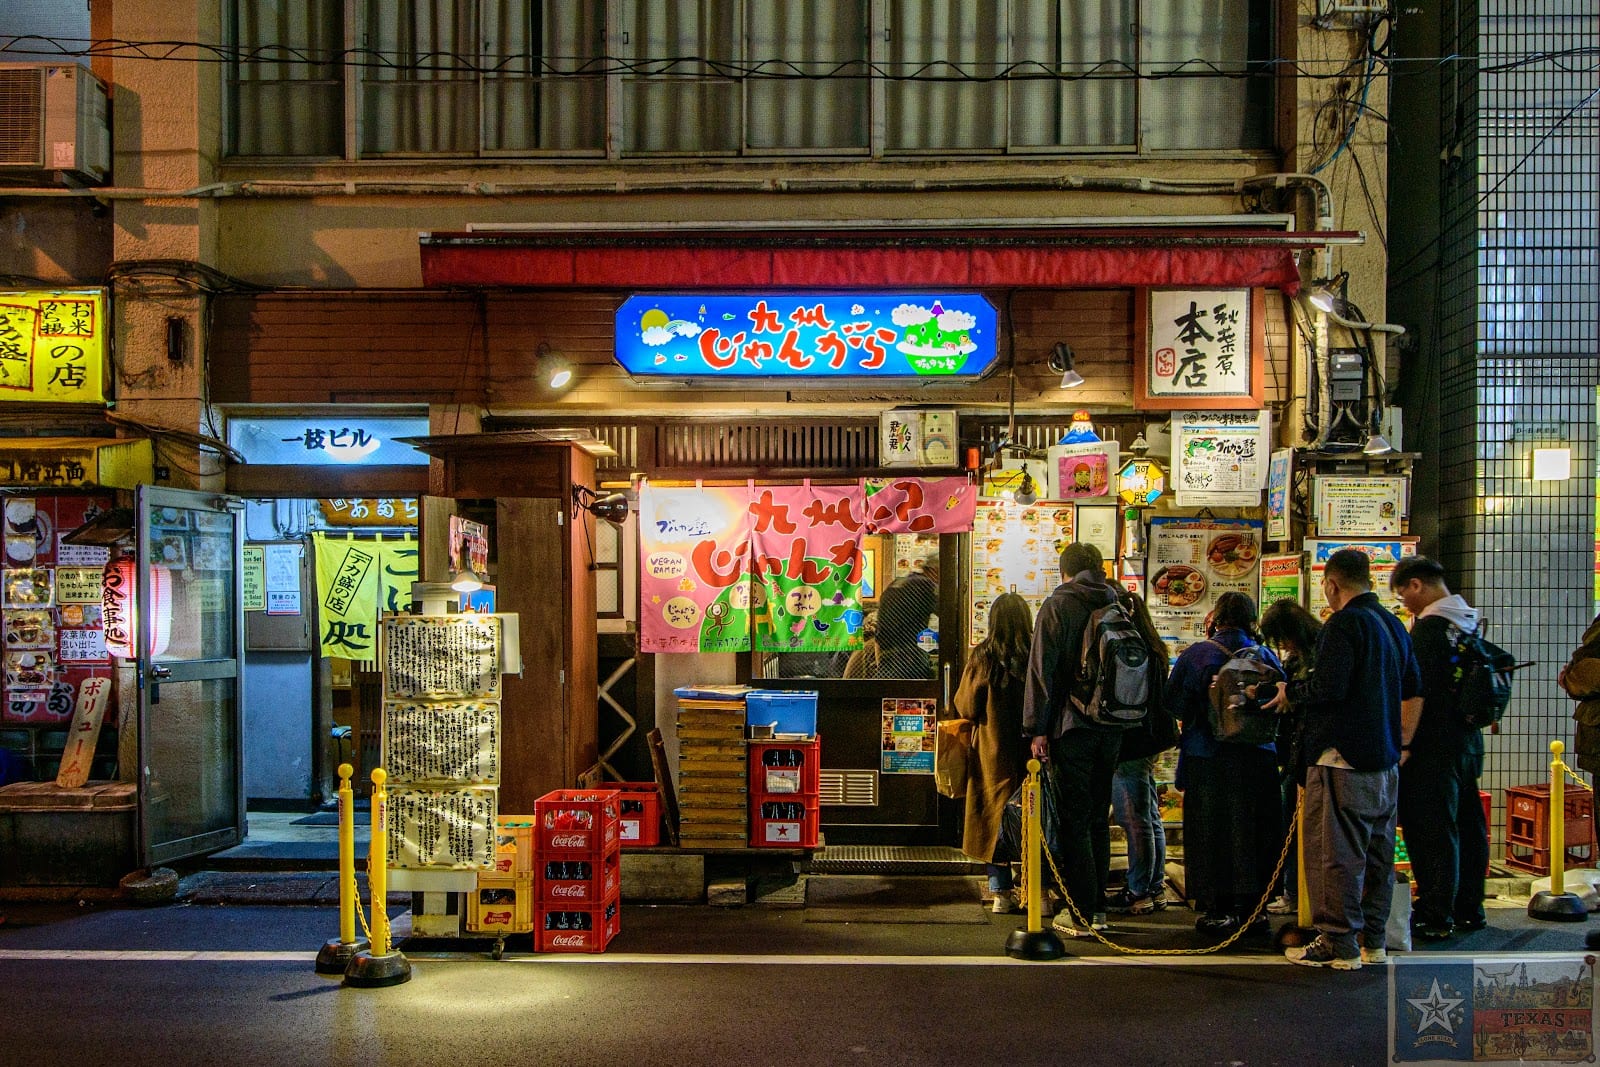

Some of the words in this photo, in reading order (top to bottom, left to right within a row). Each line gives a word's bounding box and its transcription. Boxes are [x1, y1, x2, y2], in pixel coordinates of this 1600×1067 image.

[69, 302, 93, 335] お米
[748, 301, 835, 334] 九州
[699, 321, 897, 370] じゃんがら
[1171, 301, 1215, 388] 本店
[1212, 303, 1239, 376] 秋葉原
[47, 345, 87, 388] の店
[281, 427, 373, 450] 一枝ビル
[650, 557, 682, 566] VEGAN
[653, 566, 682, 575] RAMEN
[329, 553, 374, 612] デカ盛の店
[102, 565, 128, 645] お食事処
[322, 619, 372, 650] 処
[62, 679, 104, 774] ボリューム
[552, 834, 585, 848] Coca-Cola
[552, 884, 585, 897] Coca-Cola
[553, 934, 586, 947] Coca-Cola
